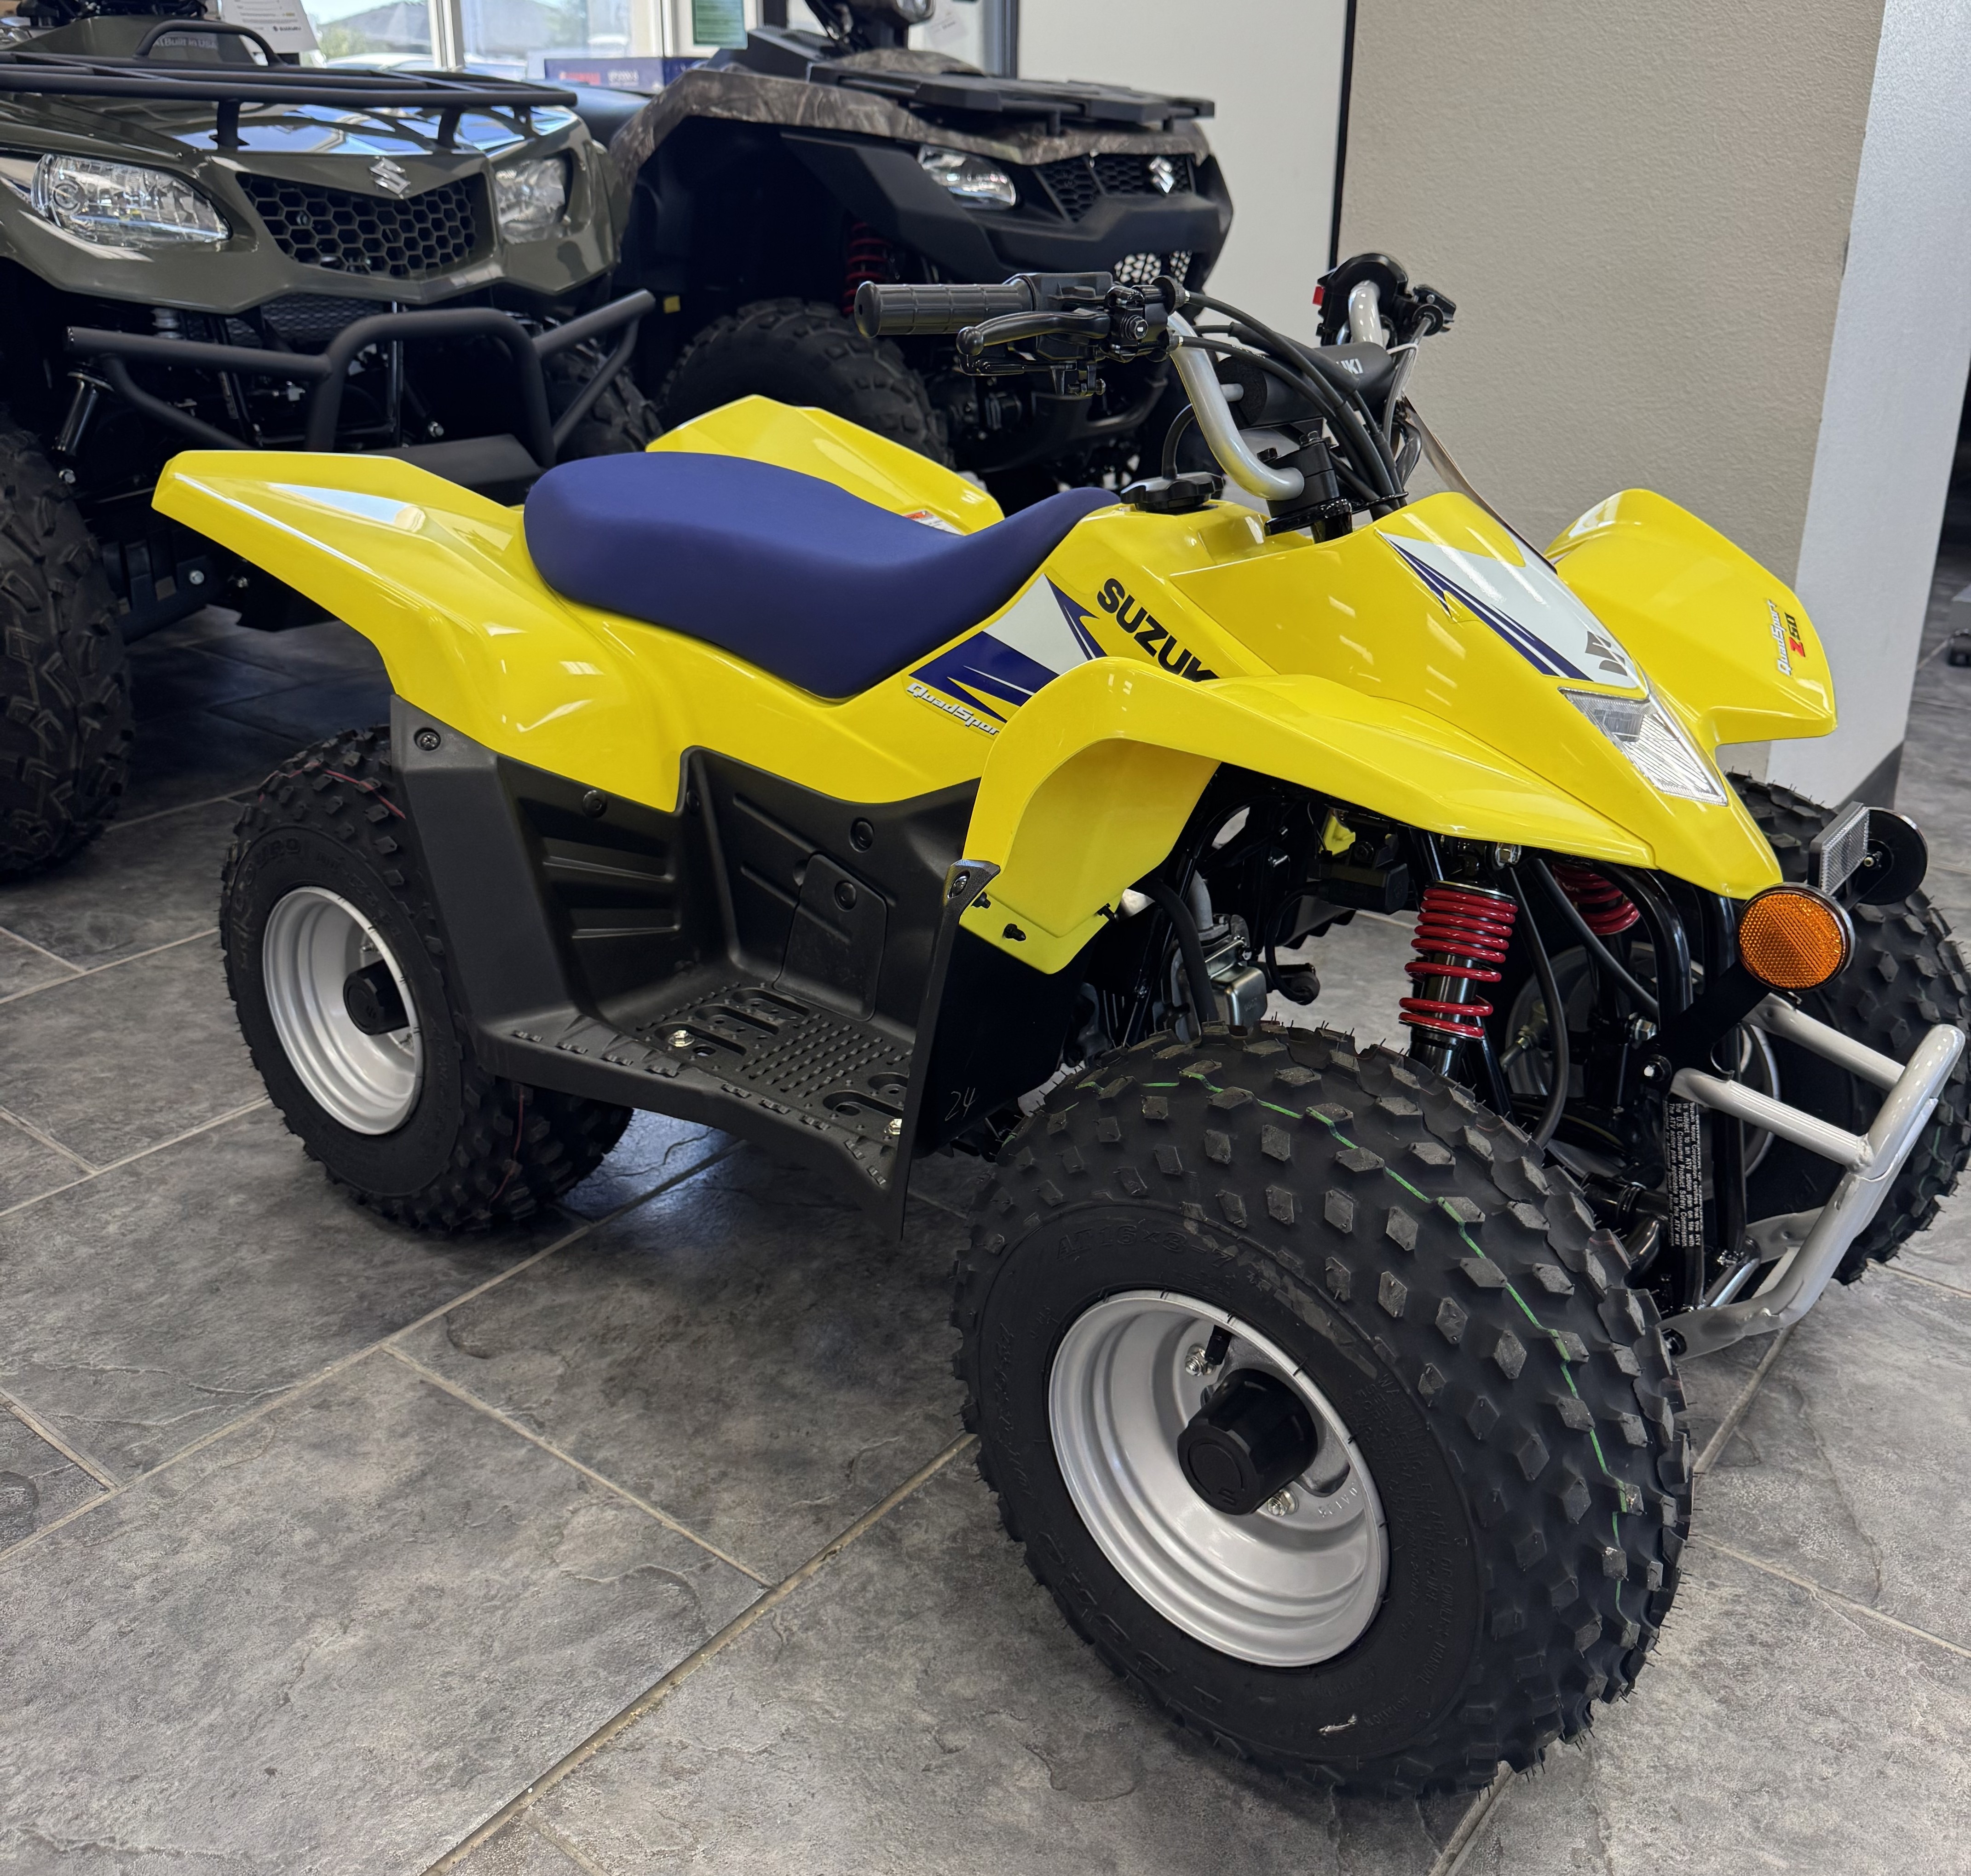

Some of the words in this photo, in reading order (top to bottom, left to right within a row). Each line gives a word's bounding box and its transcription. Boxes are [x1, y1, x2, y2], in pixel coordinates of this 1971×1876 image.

[1097, 578, 1220, 682] SUZUK
[1767, 599, 1792, 676] QuadSport
[1784, 612, 1805, 658] Z50
[906, 682, 1000, 735] QuadSpor
[945, 1086, 978, 1121] 24
[1678, 1190, 1686, 1209] Safety
